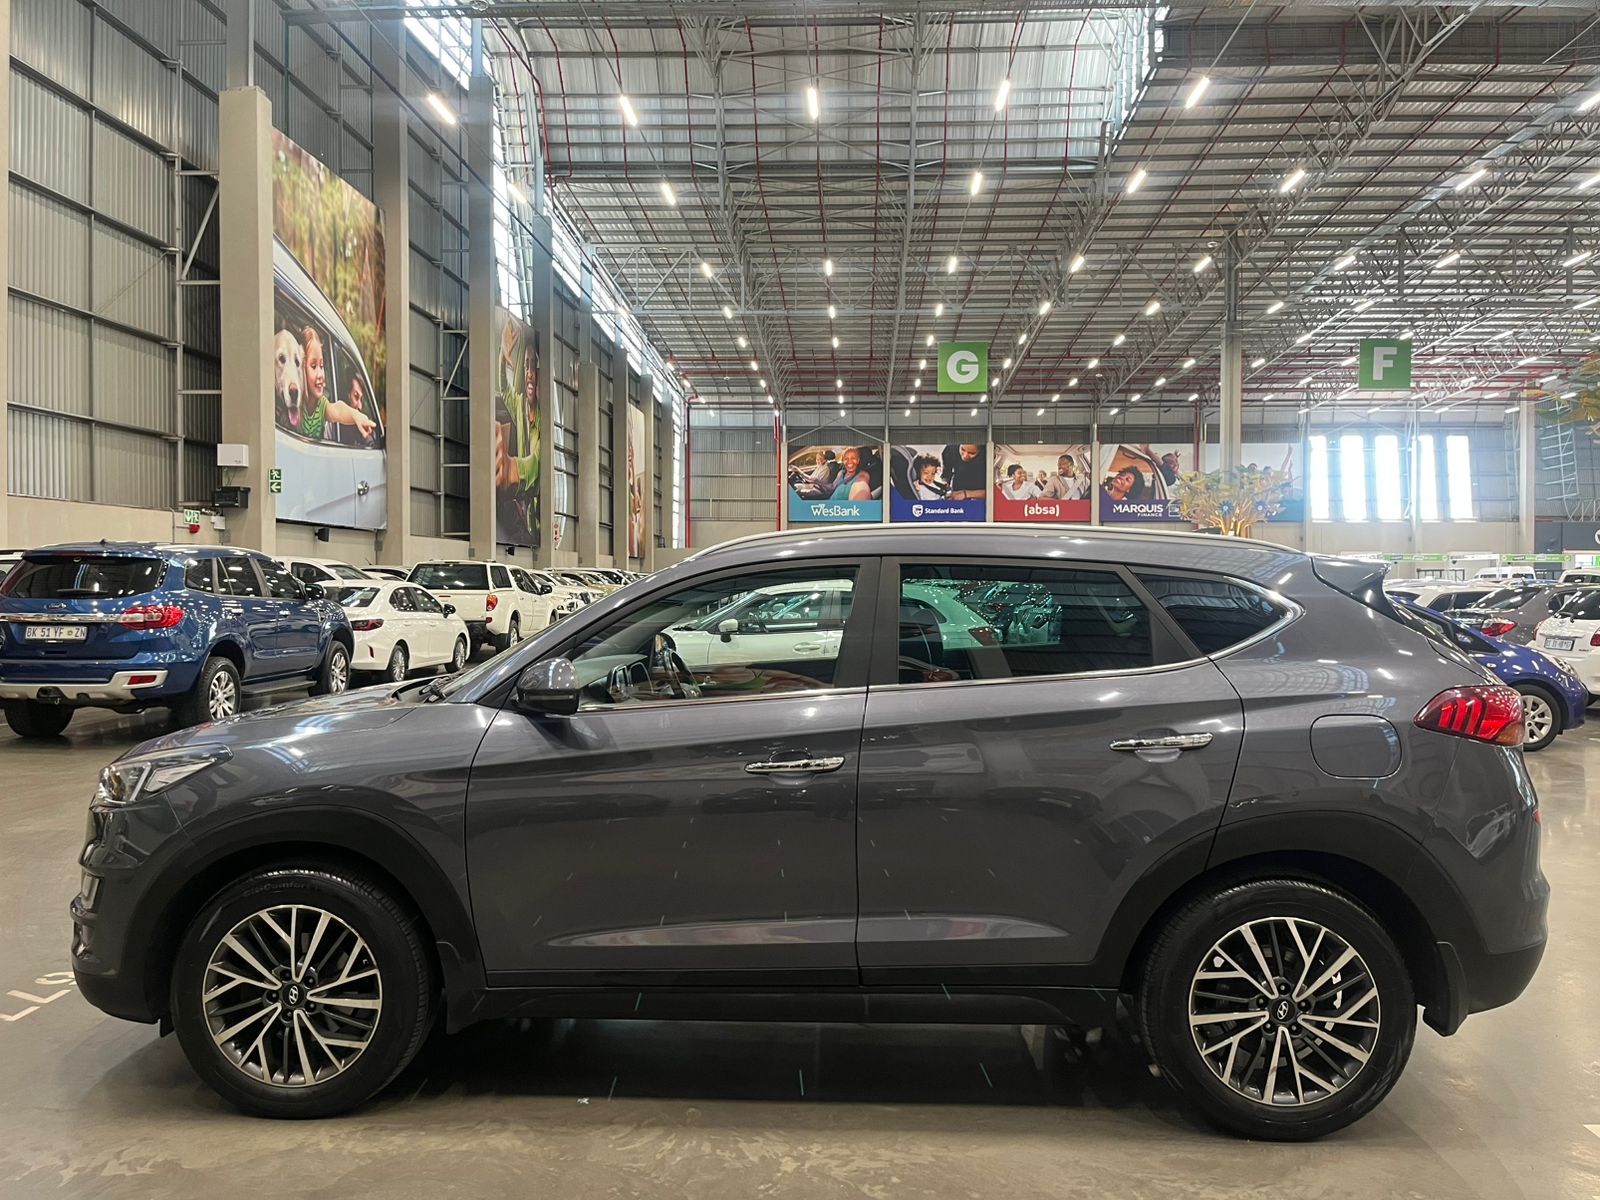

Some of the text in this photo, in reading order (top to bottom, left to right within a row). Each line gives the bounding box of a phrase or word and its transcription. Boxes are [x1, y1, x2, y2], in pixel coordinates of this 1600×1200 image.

[947, 350, 979, 384] G
[1373, 347, 1397, 380] F
[811, 504, 860, 516] WesBank
[1113, 504, 1163, 513] MARQUIS
[40, 627, 51, 638] 51
[54, 627, 65, 638] YF
[74, 627, 86, 638] ZN
